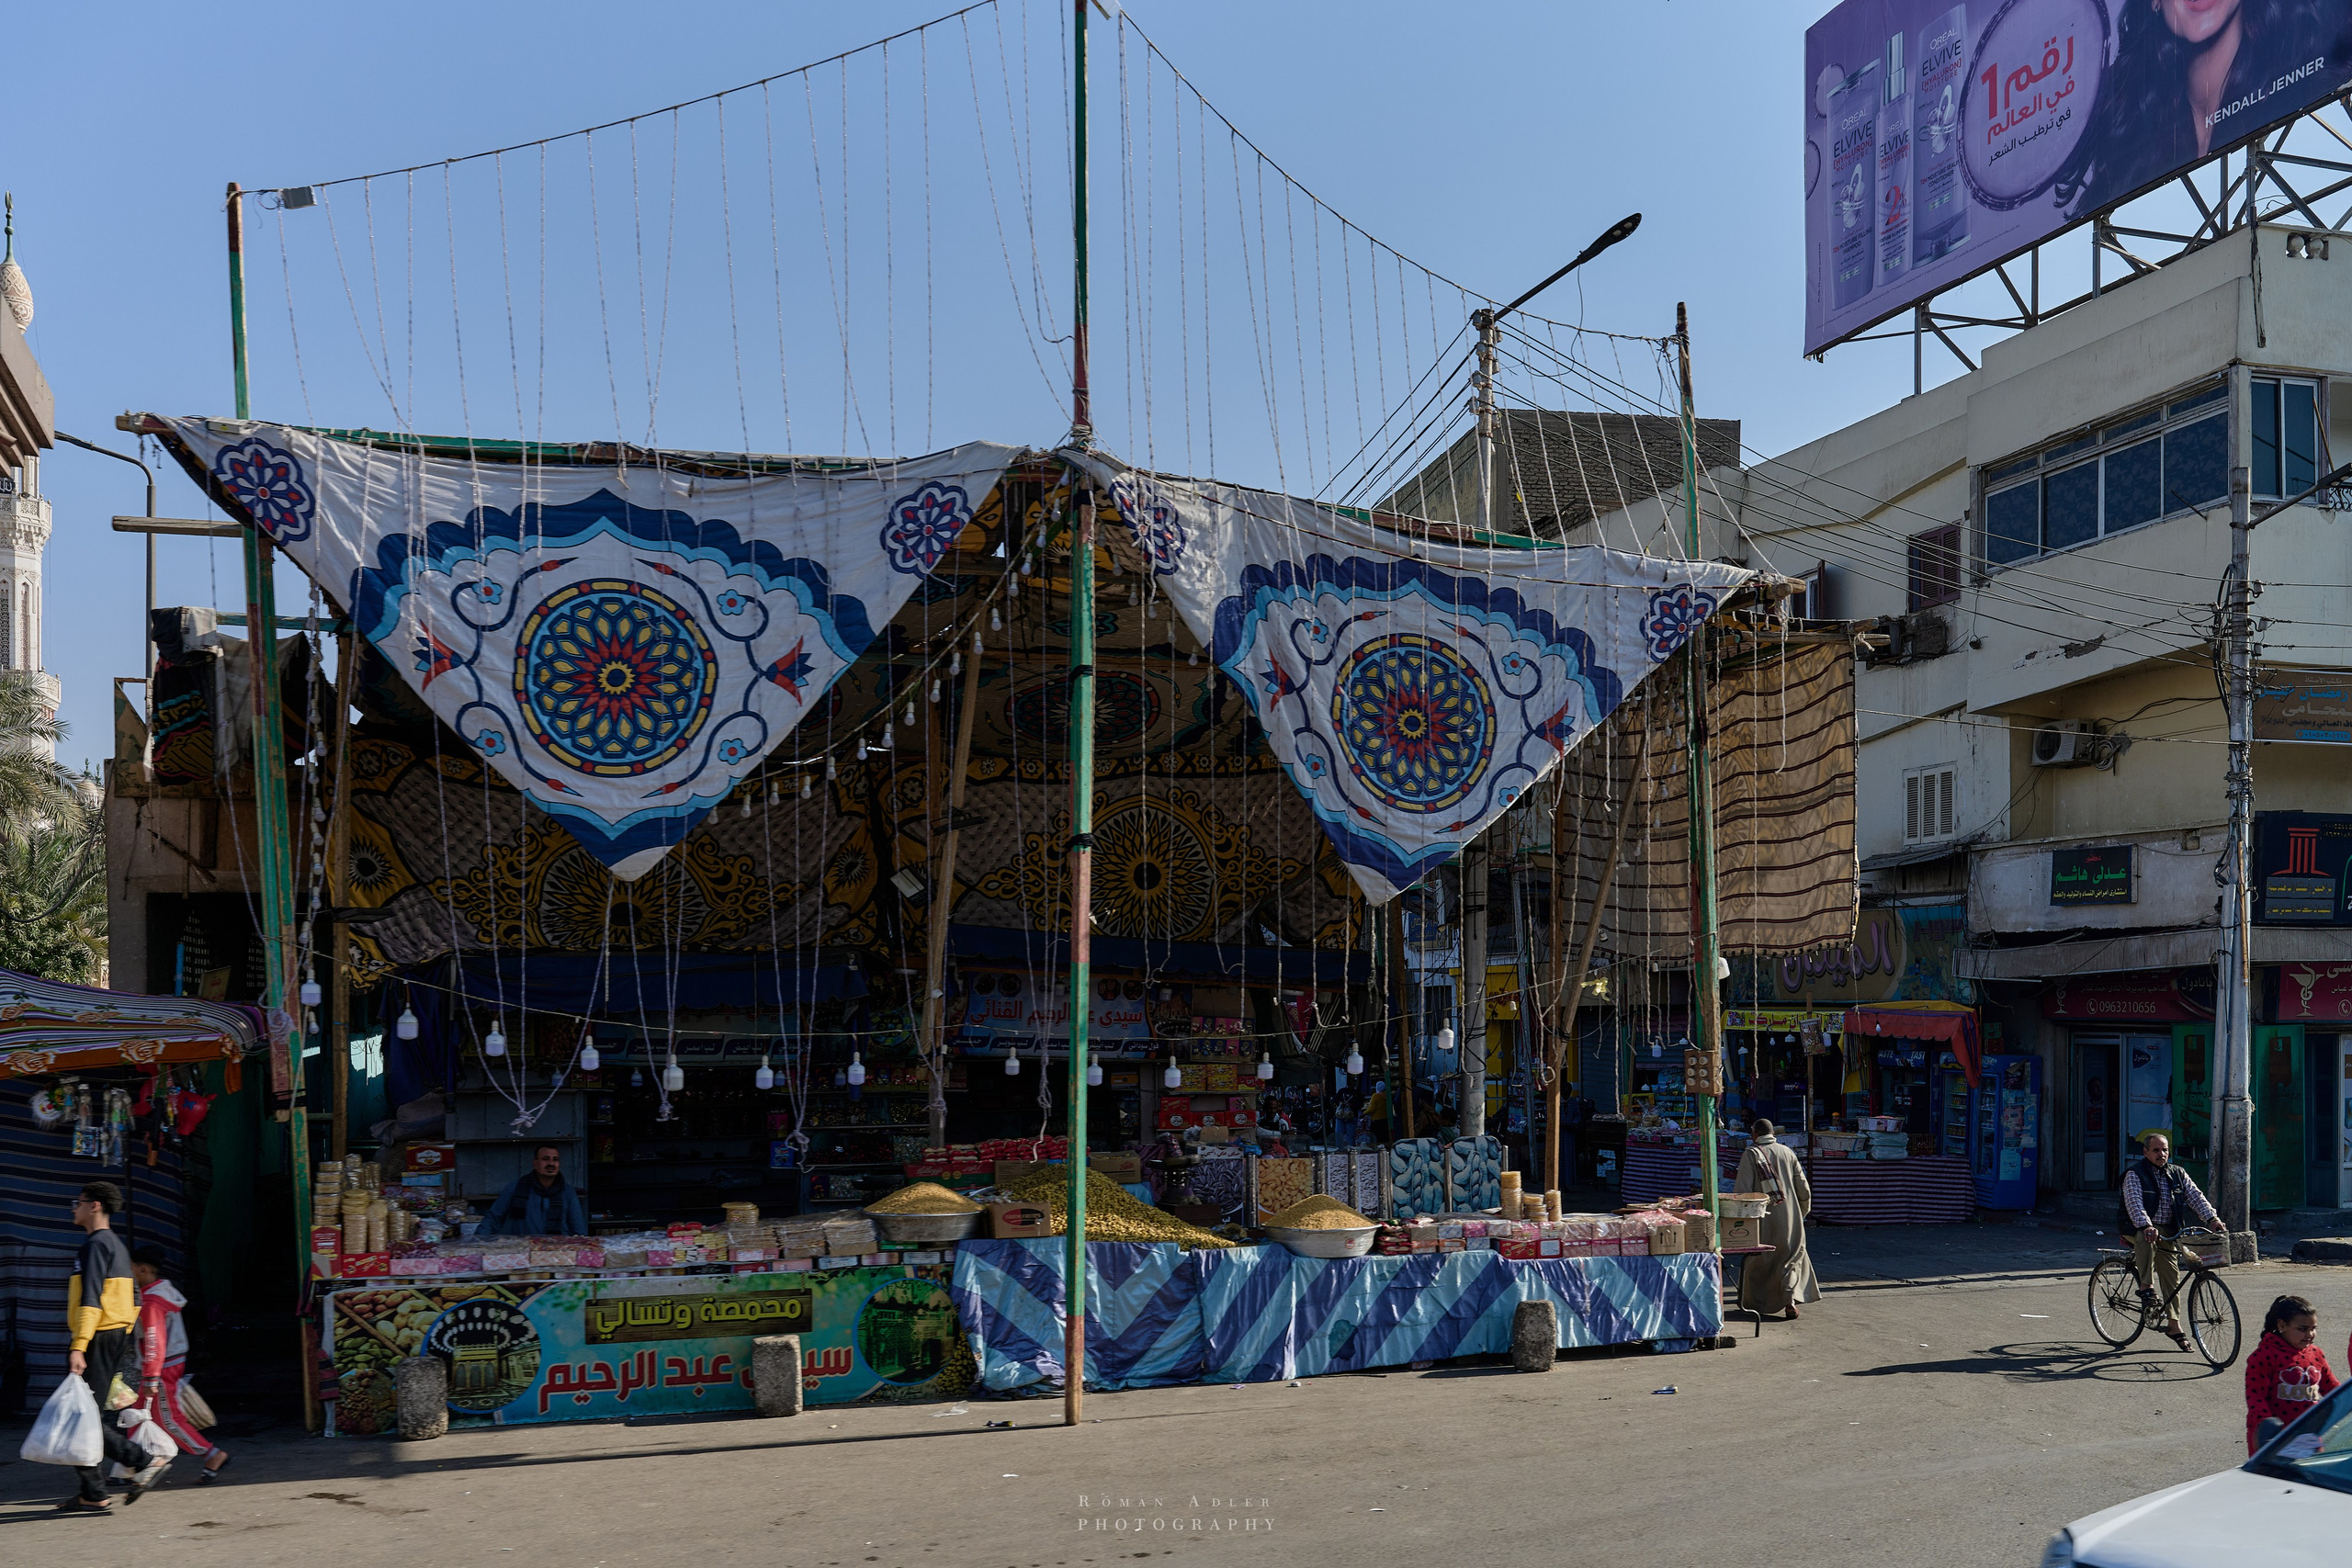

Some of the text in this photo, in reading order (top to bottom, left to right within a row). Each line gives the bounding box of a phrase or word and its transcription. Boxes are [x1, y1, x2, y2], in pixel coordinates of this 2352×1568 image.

[1922, 39, 1962, 76] ELVIVE
[1922, 57, 1962, 91] [HYALURON]
[1924, 70, 1958, 95] MOISTURE
[1981, 36, 2074, 120] رقم 1
[2205, 56, 2324, 129] KENDALL JENNER
[1987, 75, 2075, 145] في العالم
[2055, 107, 2071, 130] في
[1834, 120, 1872, 158] ELVIVE
[1880, 129, 1910, 158] ELVIVE
[1989, 138, 2017, 166] الشعر
[1836, 148, 1870, 174] MOISTURE
[2299, 684, 2348, 702] رمضان
[2281, 702, 2352, 717] محامى
[2085, 853, 2101, 863] دكتور
[2055, 864, 2088, 886] هاشم
[2181, 976, 2213, 990] بانادول
[2099, 1001, 2156, 1014] 0963210656
[595, 1296, 802, 1340] محمصة وتسالي
[538, 1348, 658, 1416] الرحيم
[665, 1354, 734, 1397] عبد
